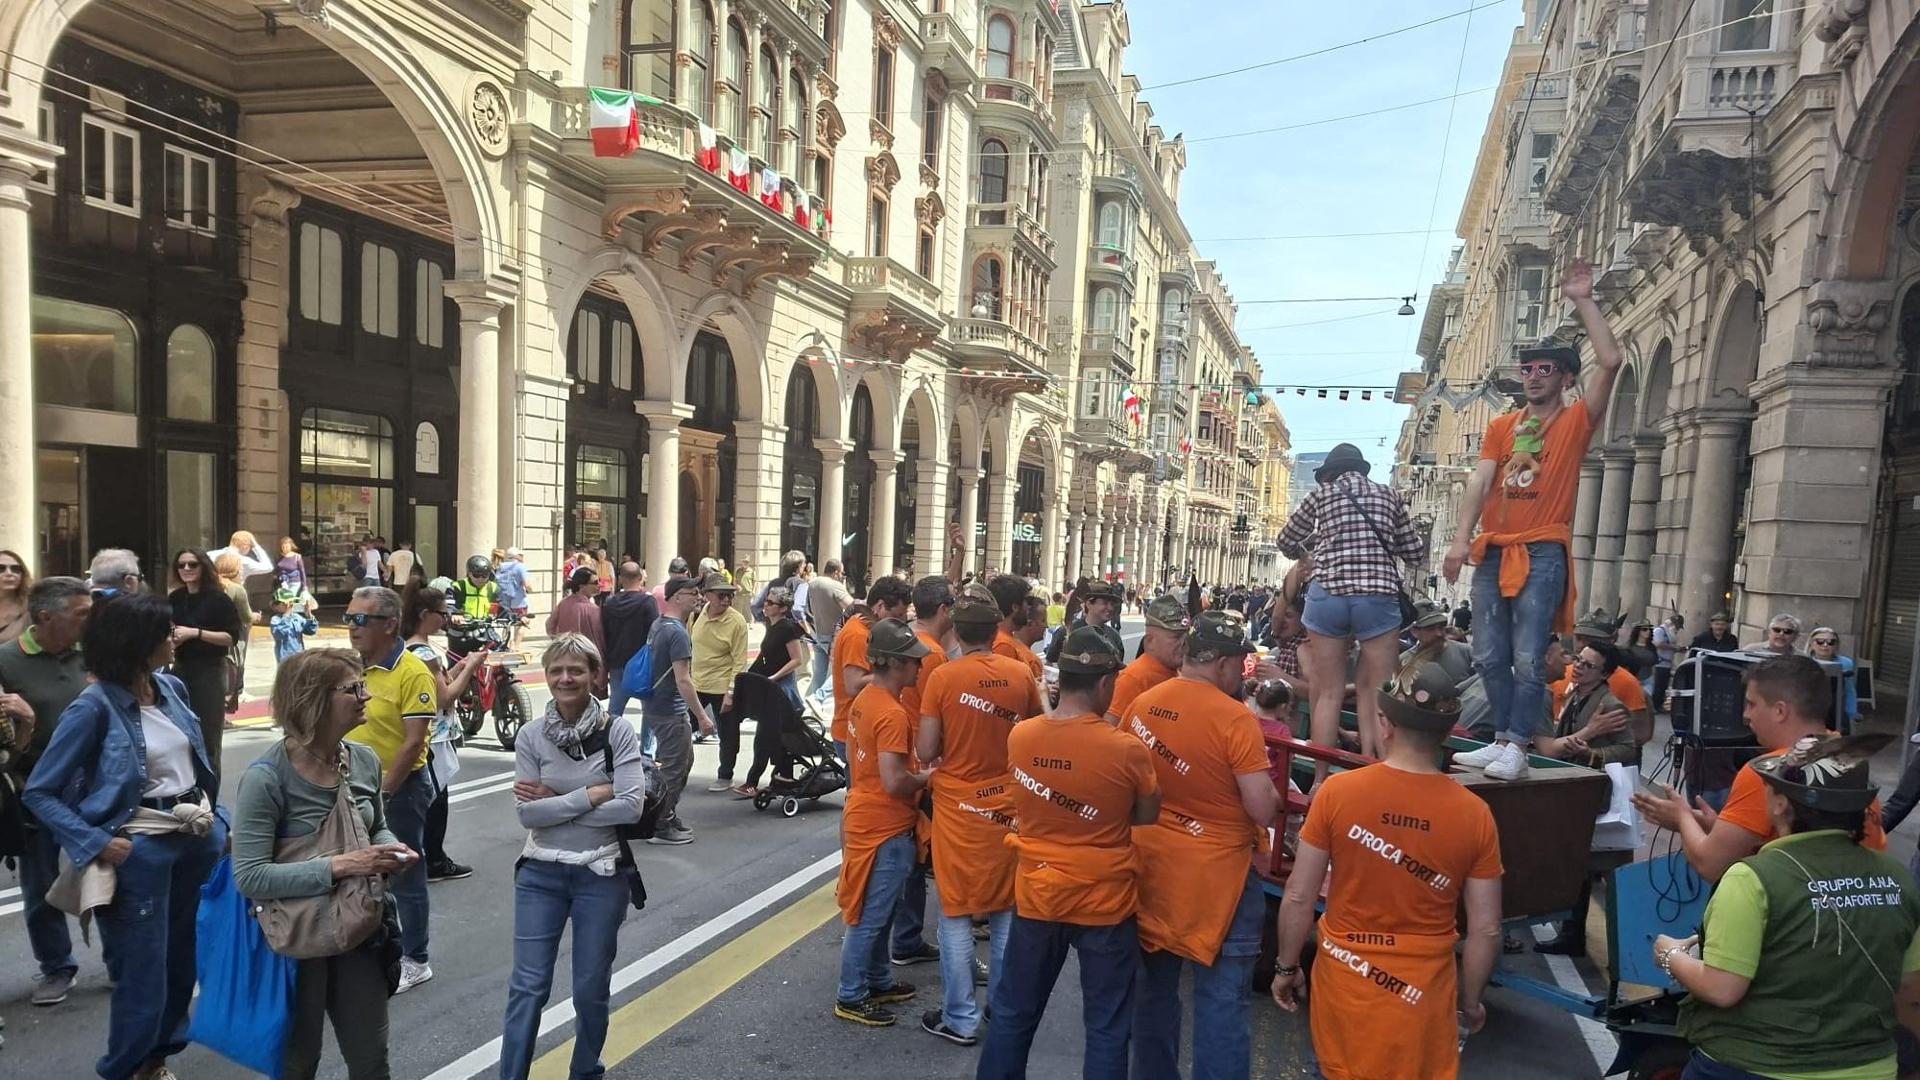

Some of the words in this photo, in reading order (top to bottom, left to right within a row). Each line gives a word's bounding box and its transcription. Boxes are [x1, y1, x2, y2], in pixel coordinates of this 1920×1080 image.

[978, 679, 1009, 688] suma
[959, 692, 1022, 725] D'ROCAFORT!!
[1147, 705, 1180, 722] suma
[1130, 715, 1191, 776] D'ROCAFORT!!!
[1032, 756, 1072, 771] suma
[976, 785, 1004, 799] suma
[1014, 767, 1099, 821] D'ROCAFORT!!!
[1381, 812, 1431, 831] suma
[1347, 824, 1450, 890] D'ROCAFORT!!!
[1807, 877, 1864, 894] GRUPPO
[1346, 932, 1396, 947] suma
[1321, 937, 1424, 1006] DROCAFORT!!!
